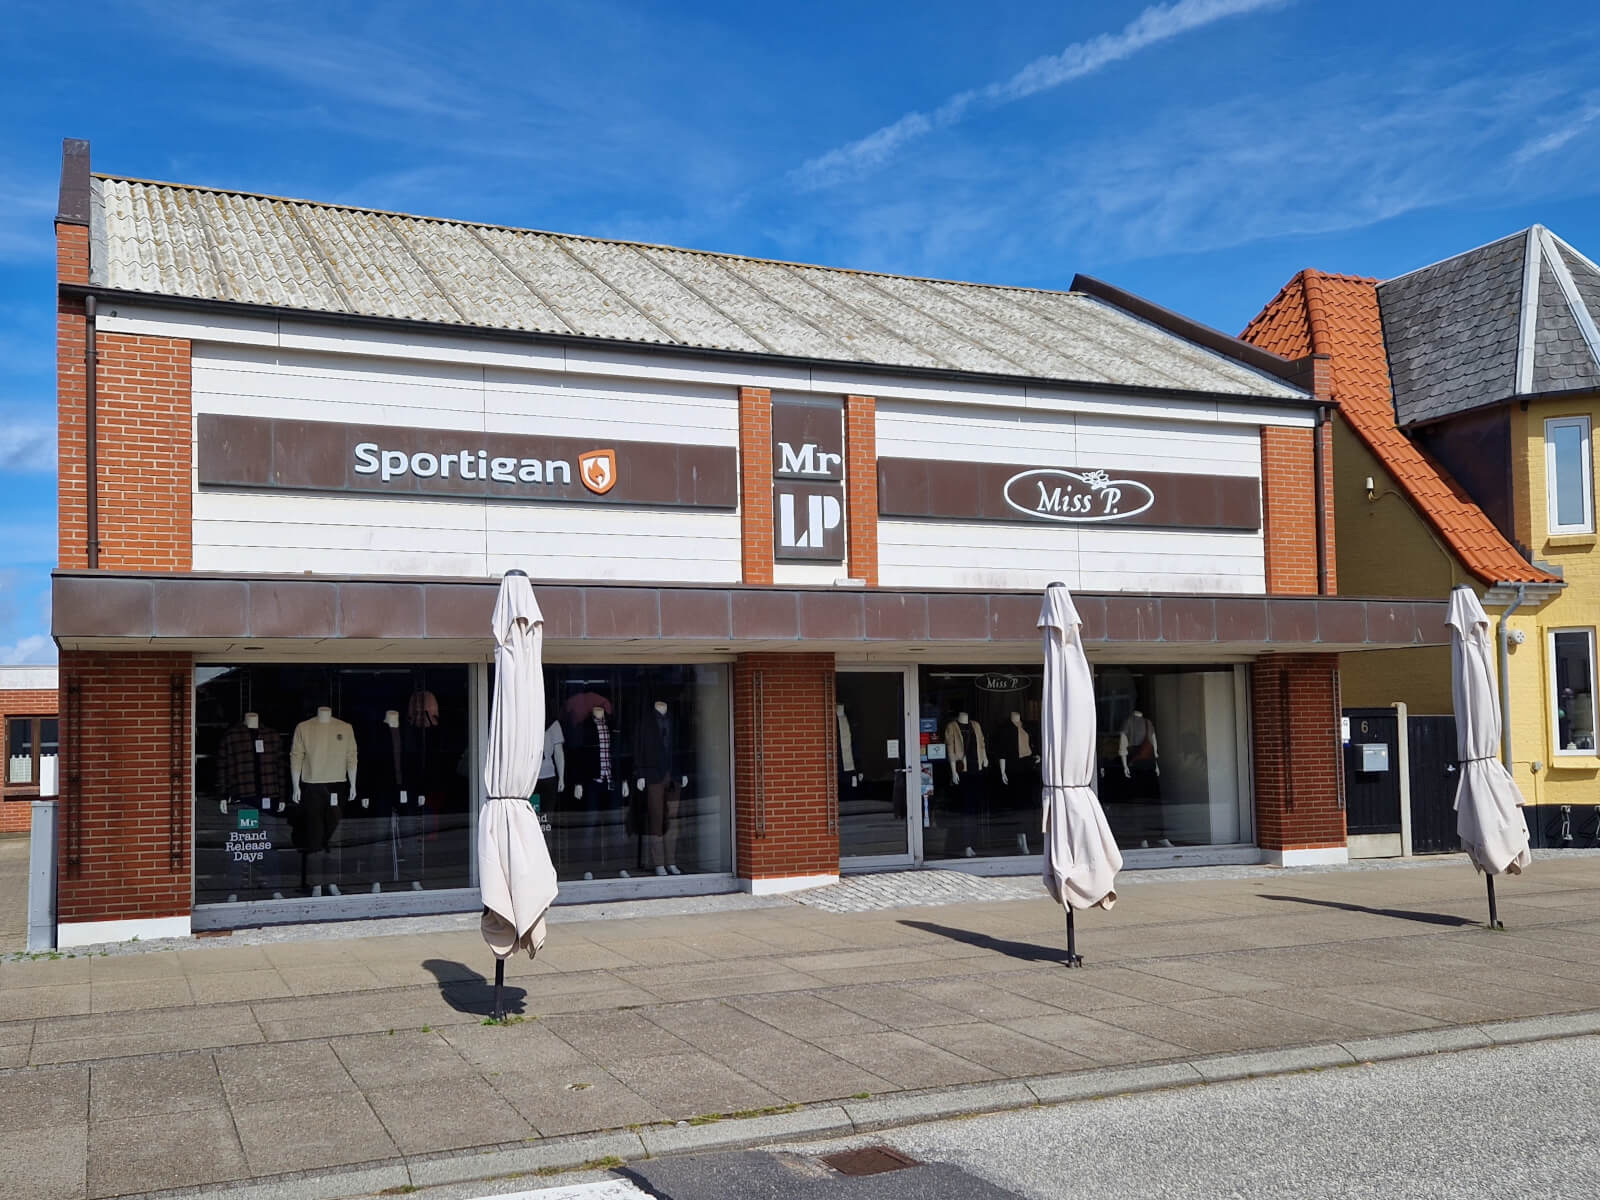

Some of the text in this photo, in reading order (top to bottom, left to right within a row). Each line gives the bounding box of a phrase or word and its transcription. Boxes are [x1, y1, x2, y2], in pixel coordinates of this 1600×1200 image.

[354, 442, 571, 484] Sportigan
[778, 442, 841, 475] Mr
[1036, 481, 1121, 514] Miss P.
[779, 493, 841, 548] LP
[986, 676, 1007, 689] Miss
[1360, 720, 1369, 734] 6
[240, 818, 258, 827] Mr
[229, 830, 267, 842] Brand
[225, 841, 272, 852] Release
[233, 851, 264, 863] Days
